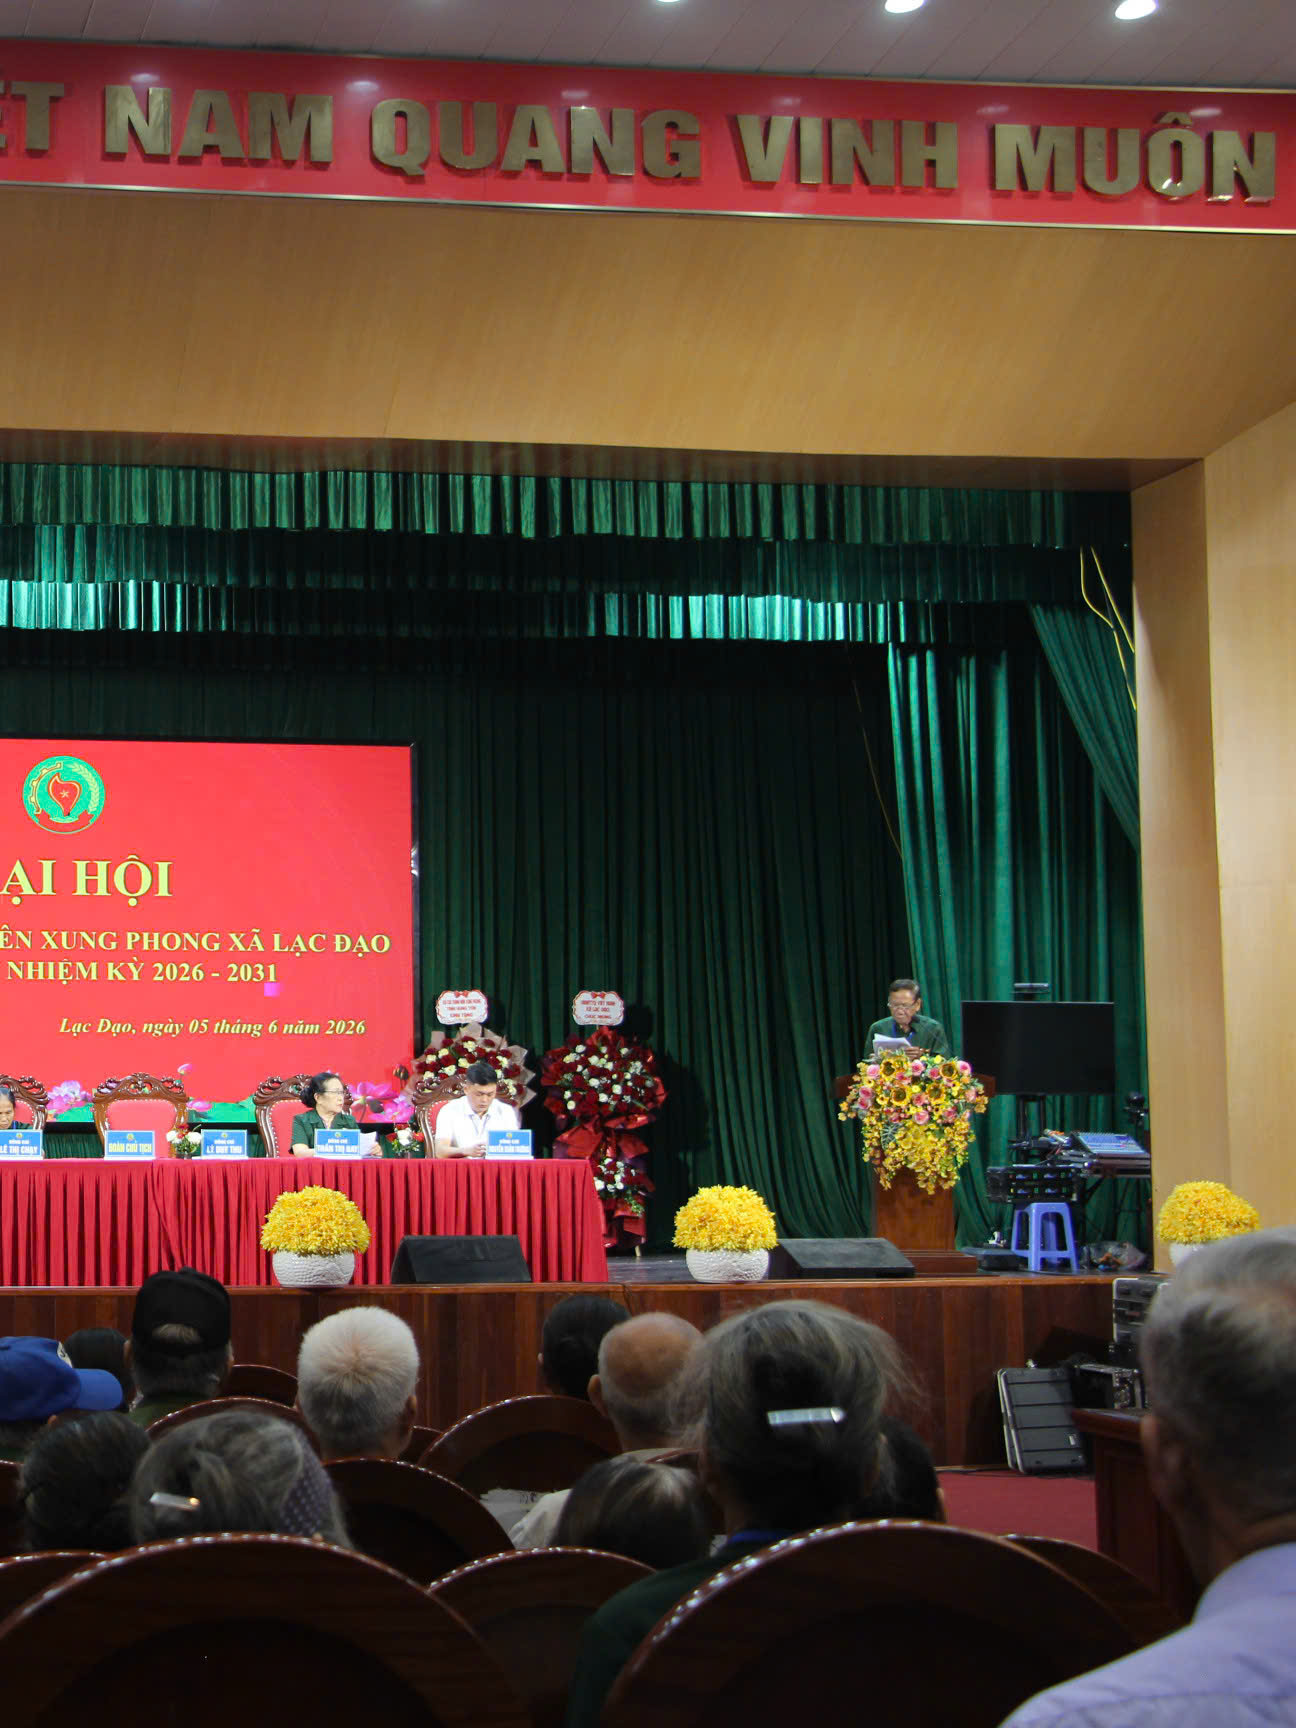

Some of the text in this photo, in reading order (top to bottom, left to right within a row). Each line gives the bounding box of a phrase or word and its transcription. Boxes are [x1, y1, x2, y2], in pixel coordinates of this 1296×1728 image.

[104, 85, 334, 163] NAM
[370, 97, 701, 178] QUANG
[735, 114, 958, 191] VINH
[994, 111, 1276, 202] MUÔN
[72, 855, 173, 907] HỘI
[40, 930, 118, 951] XUNG
[126, 932, 222, 952] PHONG
[228, 928, 265, 952] XÃ
[272, 933, 326, 957] LẠC
[333, 933, 391, 958] ĐẠO
[7, 958, 98, 985] NHIỆM
[106, 956, 145, 981] KỲ
[152, 963, 205, 982] 2026
[226, 963, 278, 983] 2031
[59, 1018, 366, 1038] Lạc Đạo, ngày 05 tháng 6 năm 2026
